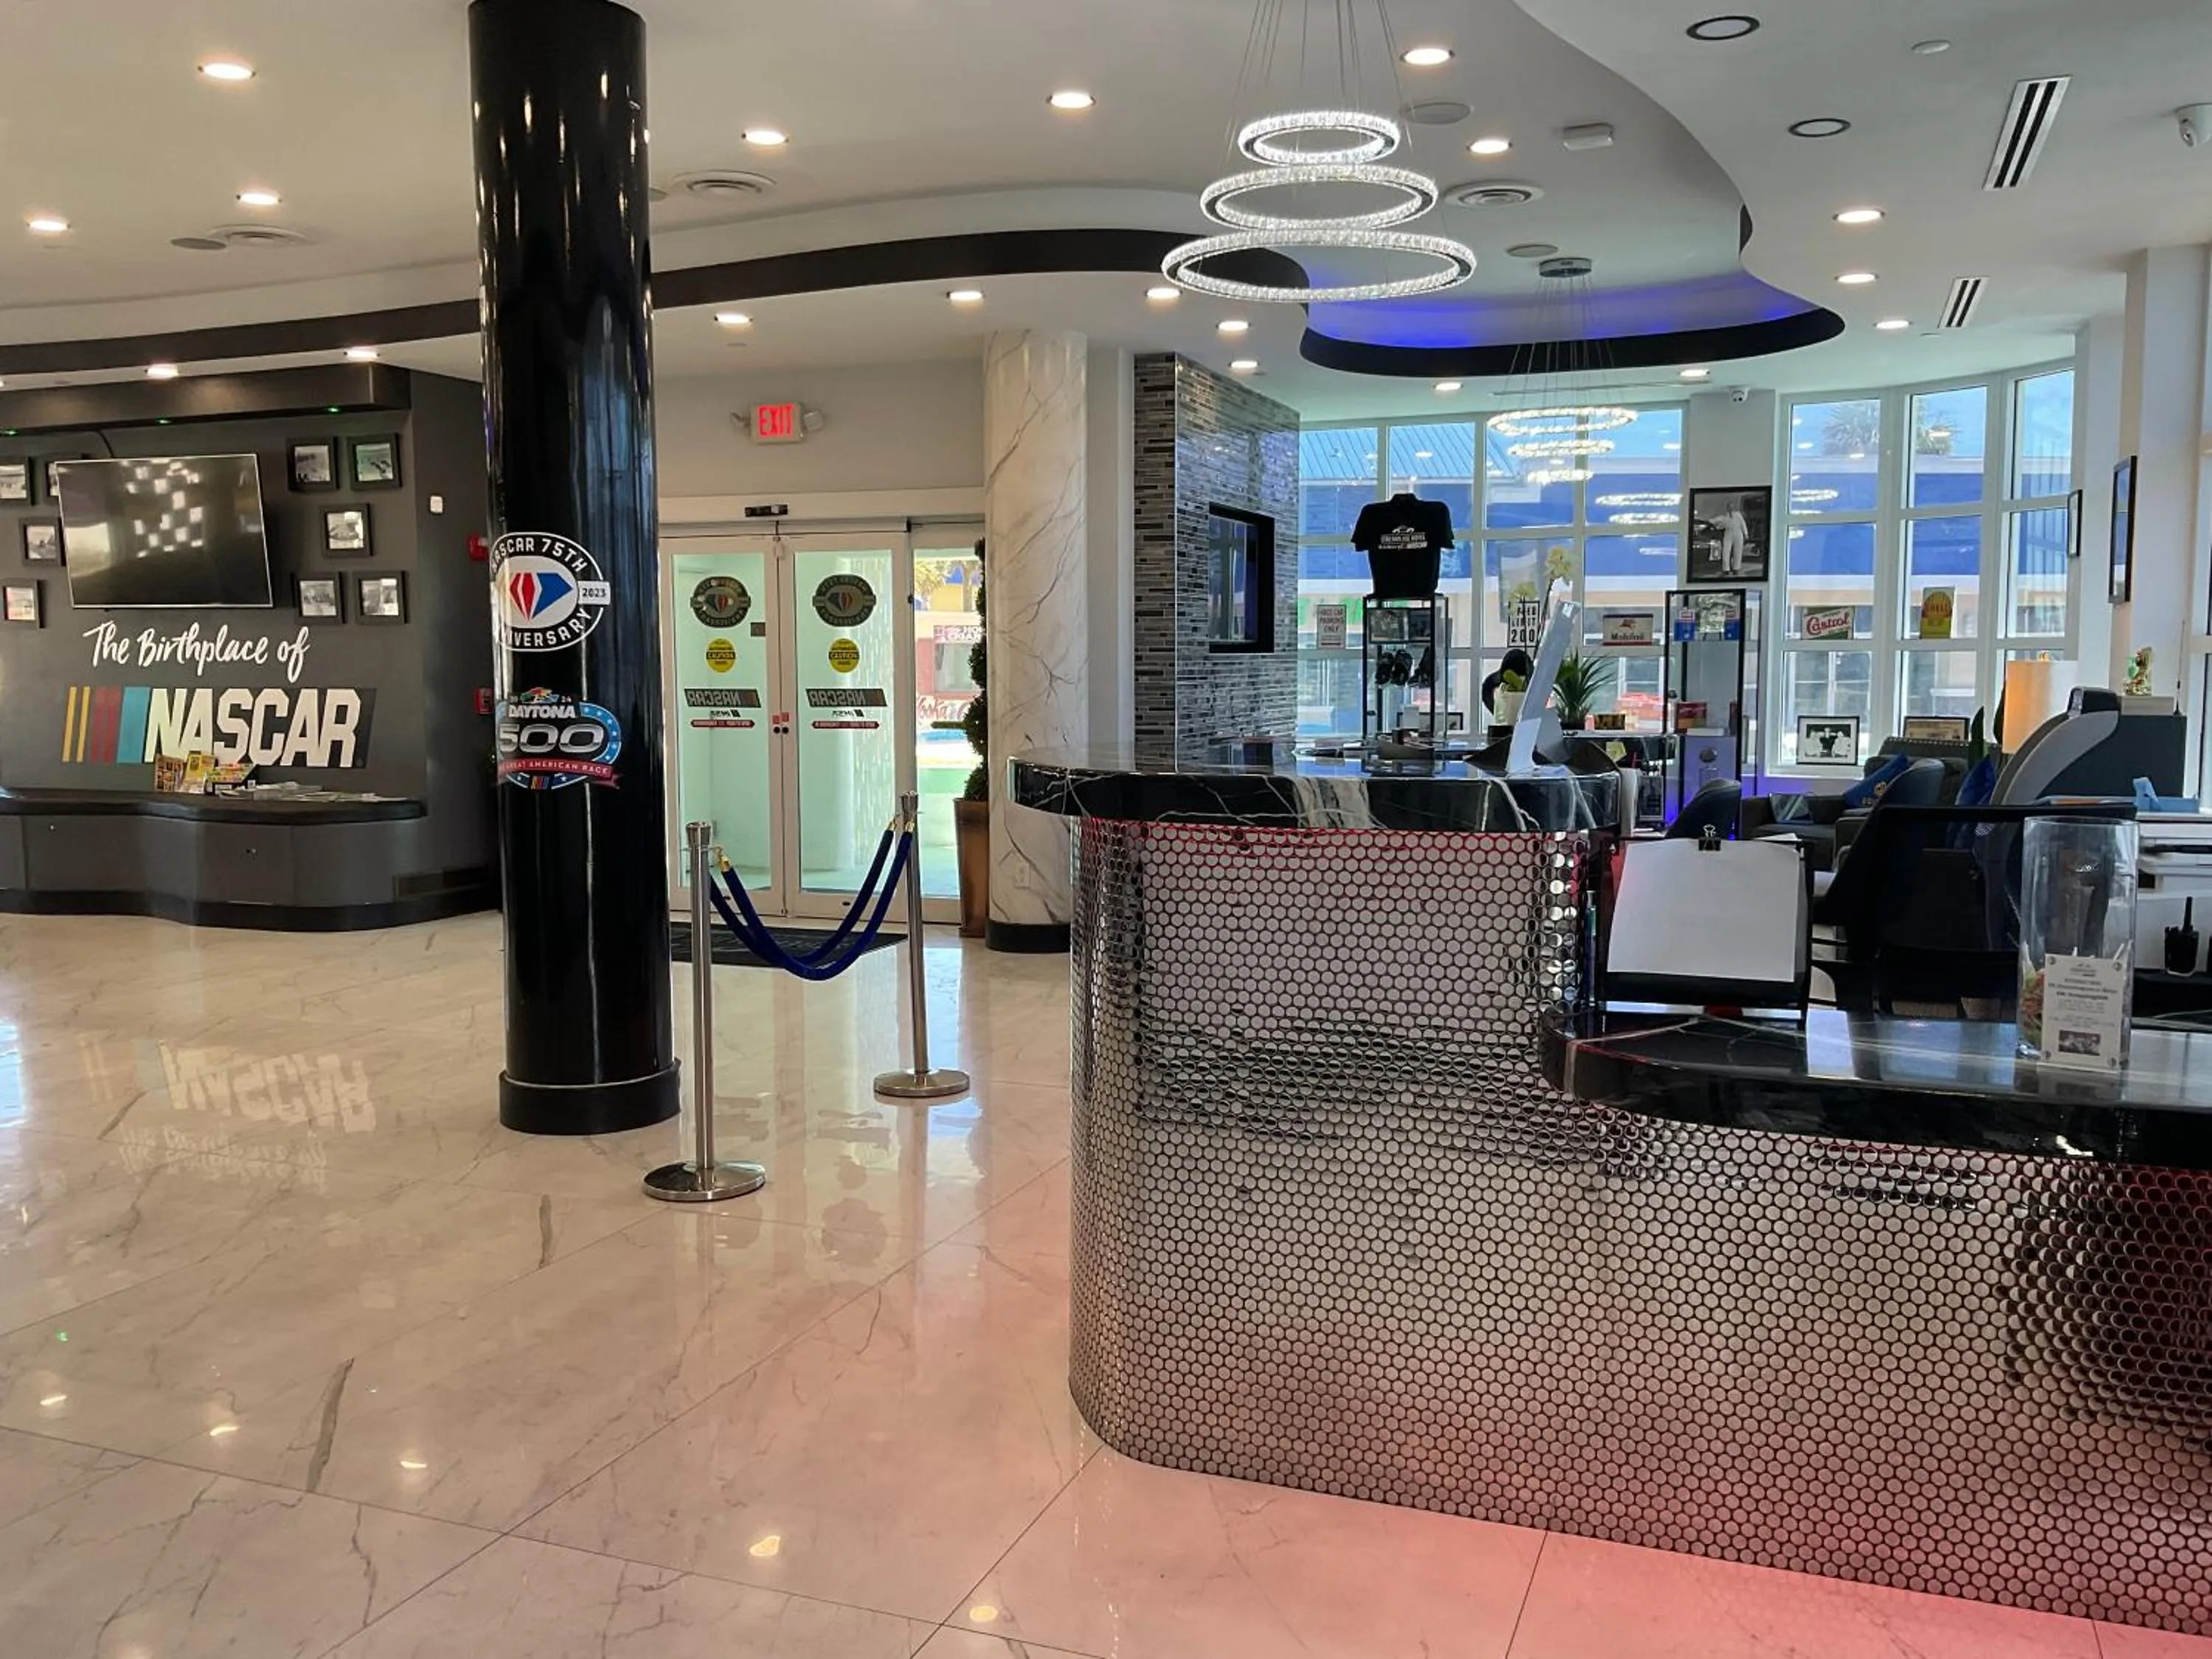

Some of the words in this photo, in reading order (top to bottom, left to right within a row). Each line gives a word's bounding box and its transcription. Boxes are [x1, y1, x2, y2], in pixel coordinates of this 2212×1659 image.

[759, 404, 794, 437] EXIT
[542, 538, 588, 572] 75TH
[582, 588, 606, 597] 2023
[1807, 611, 1850, 636] Castrol
[83, 620, 130, 666] The
[136, 622, 268, 676] Birthplace
[276, 625, 310, 684] of
[508, 705, 577, 719] DAYTONA
[144, 688, 361, 768] NASCAR
[498, 723, 605, 753] 500
[529, 761, 578, 771] AMERICAN
[581, 764, 609, 775] RACE
